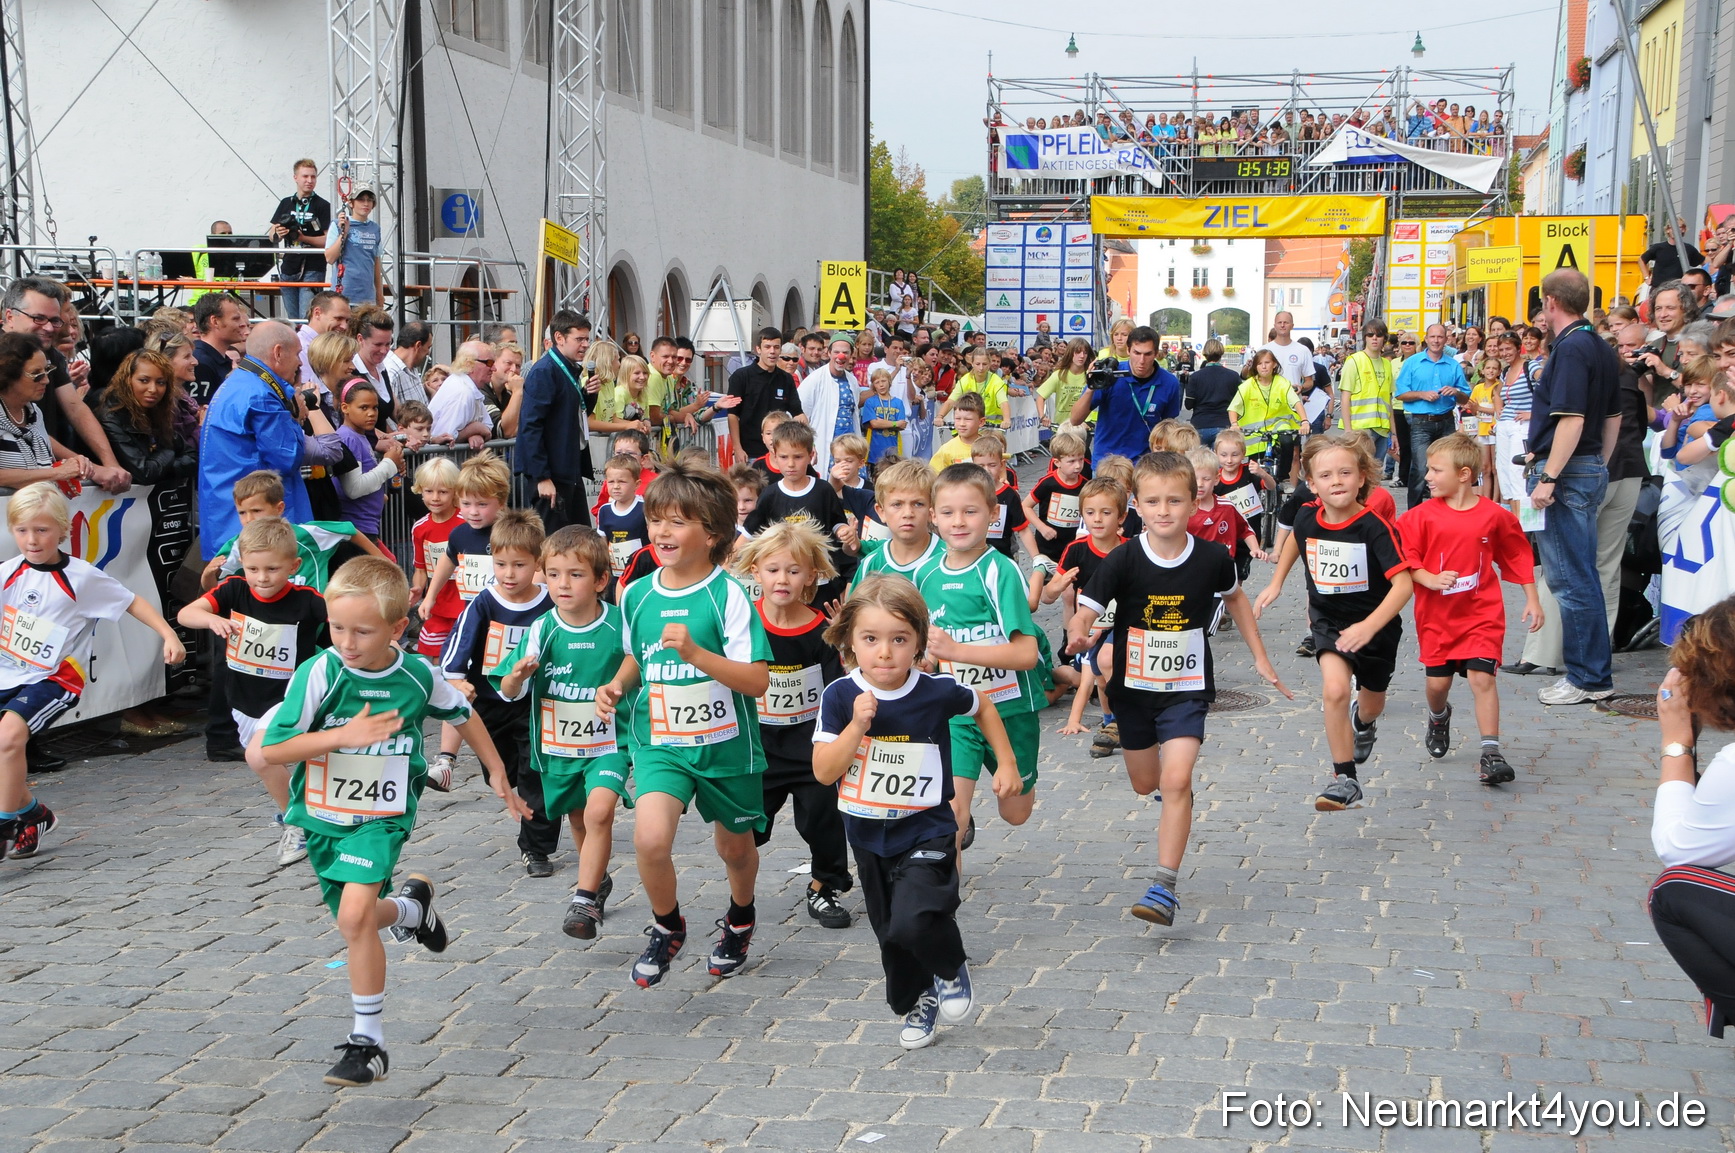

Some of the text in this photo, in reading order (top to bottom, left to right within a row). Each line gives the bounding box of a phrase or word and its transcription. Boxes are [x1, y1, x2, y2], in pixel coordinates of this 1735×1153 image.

[1237, 161, 1290, 177] 13:51:39
[1203, 205, 1268, 228] ZIEL
[1547, 223, 1589, 237] Block
[1028, 251, 1049, 260] MCM
[1470, 257, 1518, 266] Schnupper-
[1554, 244, 1580, 271] A
[827, 264, 862, 276] Block
[1486, 265, 1502, 274] lauf
[830, 282, 855, 314] A
[1060, 507, 1081, 519] 725
[1319, 545, 1339, 556] David
[466, 558, 478, 568] Mika
[1320, 562, 1358, 578] 7201
[465, 573, 496, 587] 7114
[661, 609, 689, 618] DERBYSTAR
[17, 616, 35, 631] Paul
[246, 622, 263, 637] Karl
[14, 632, 54, 659] 7055
[1148, 636, 1178, 649] Jonas
[243, 640, 289, 662] 7045
[1130, 651, 1139, 660] K2
[545, 662, 572, 678] Sport
[1148, 654, 1197, 672] 7096
[1173, 680, 1203, 689] PFLEIDERER
[359, 690, 391, 698] DERBYSTAR
[770, 687, 818, 709] 7215
[671, 700, 727, 724] 7238
[559, 720, 608, 737] 7244
[704, 727, 738, 740] PFLEIDERER
[586, 745, 616, 754] PFLEIDERER
[872, 746, 904, 764] Linus
[847, 764, 859, 776] K2
[333, 778, 397, 802] 7246
[870, 772, 933, 797] 7027
[340, 853, 373, 868] DERBYSTAR
